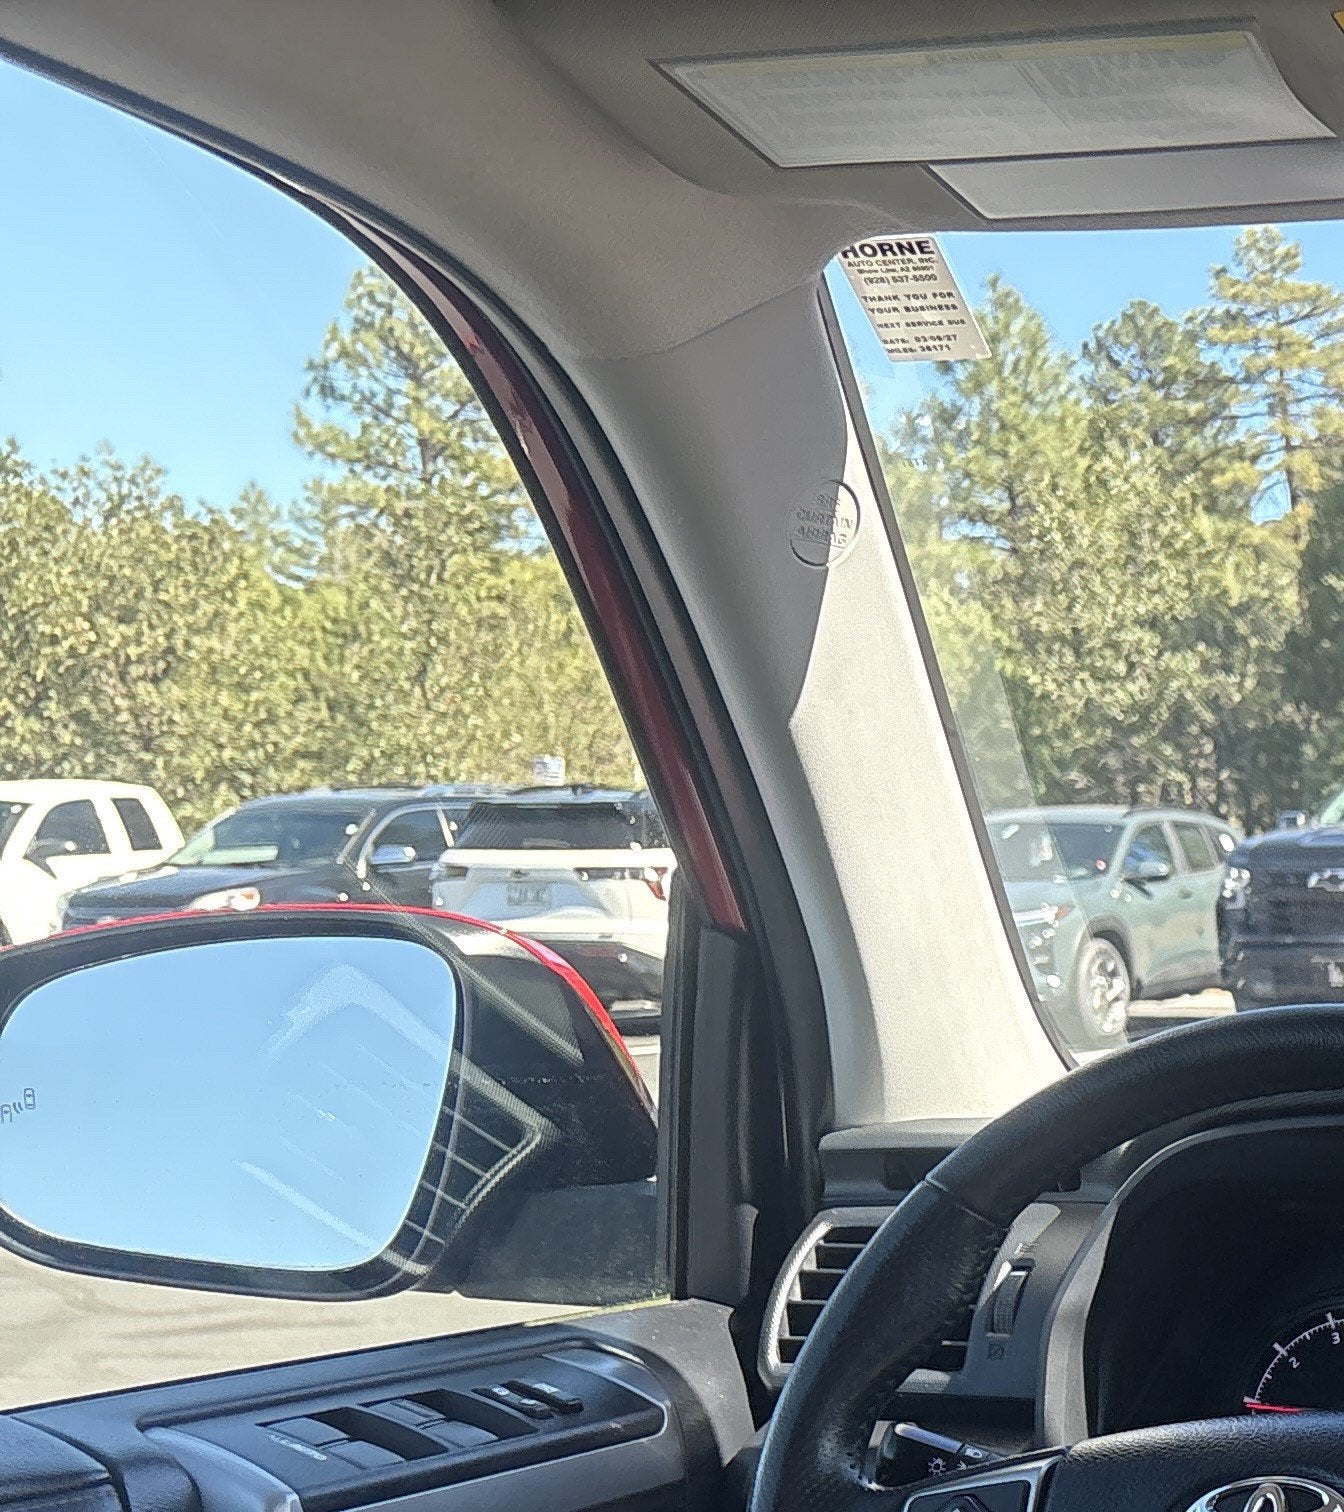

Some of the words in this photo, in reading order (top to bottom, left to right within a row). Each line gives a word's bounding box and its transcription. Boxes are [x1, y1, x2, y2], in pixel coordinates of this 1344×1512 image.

[841, 240, 935, 258] HORNE
[847, 260, 873, 268] AUTO
[860, 294, 900, 302] THANK
[903, 293, 927, 301] YOU
[931, 291, 955, 299] FOR
[868, 306, 900, 314] YOUR
[903, 304, 958, 313] BUSINESS
[905, 320, 944, 328] SERVICE
[1288, 1356, 1300, 1369] 2
[1330, 1331, 1341, 1345] 3
